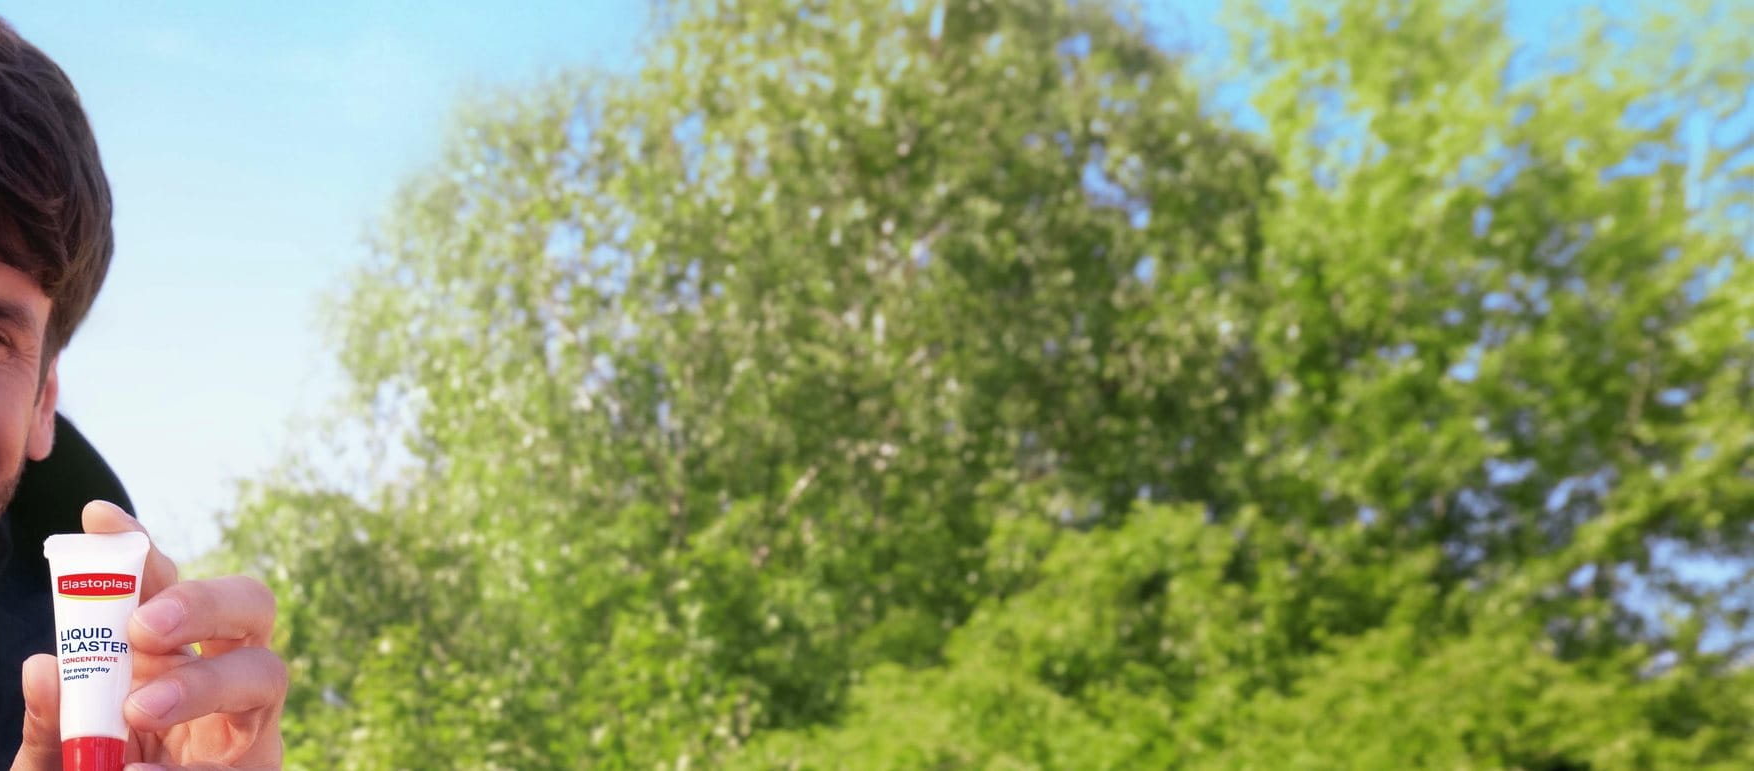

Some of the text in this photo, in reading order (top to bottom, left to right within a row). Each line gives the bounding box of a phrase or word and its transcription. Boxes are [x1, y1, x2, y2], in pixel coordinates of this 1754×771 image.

[61, 579, 132, 590] Elastoplast
[61, 627, 112, 641] LIQUID
[62, 641, 128, 654] PLASTER
[63, 656, 118, 664] CONCENTRATE
[73, 666, 110, 674] everyday
